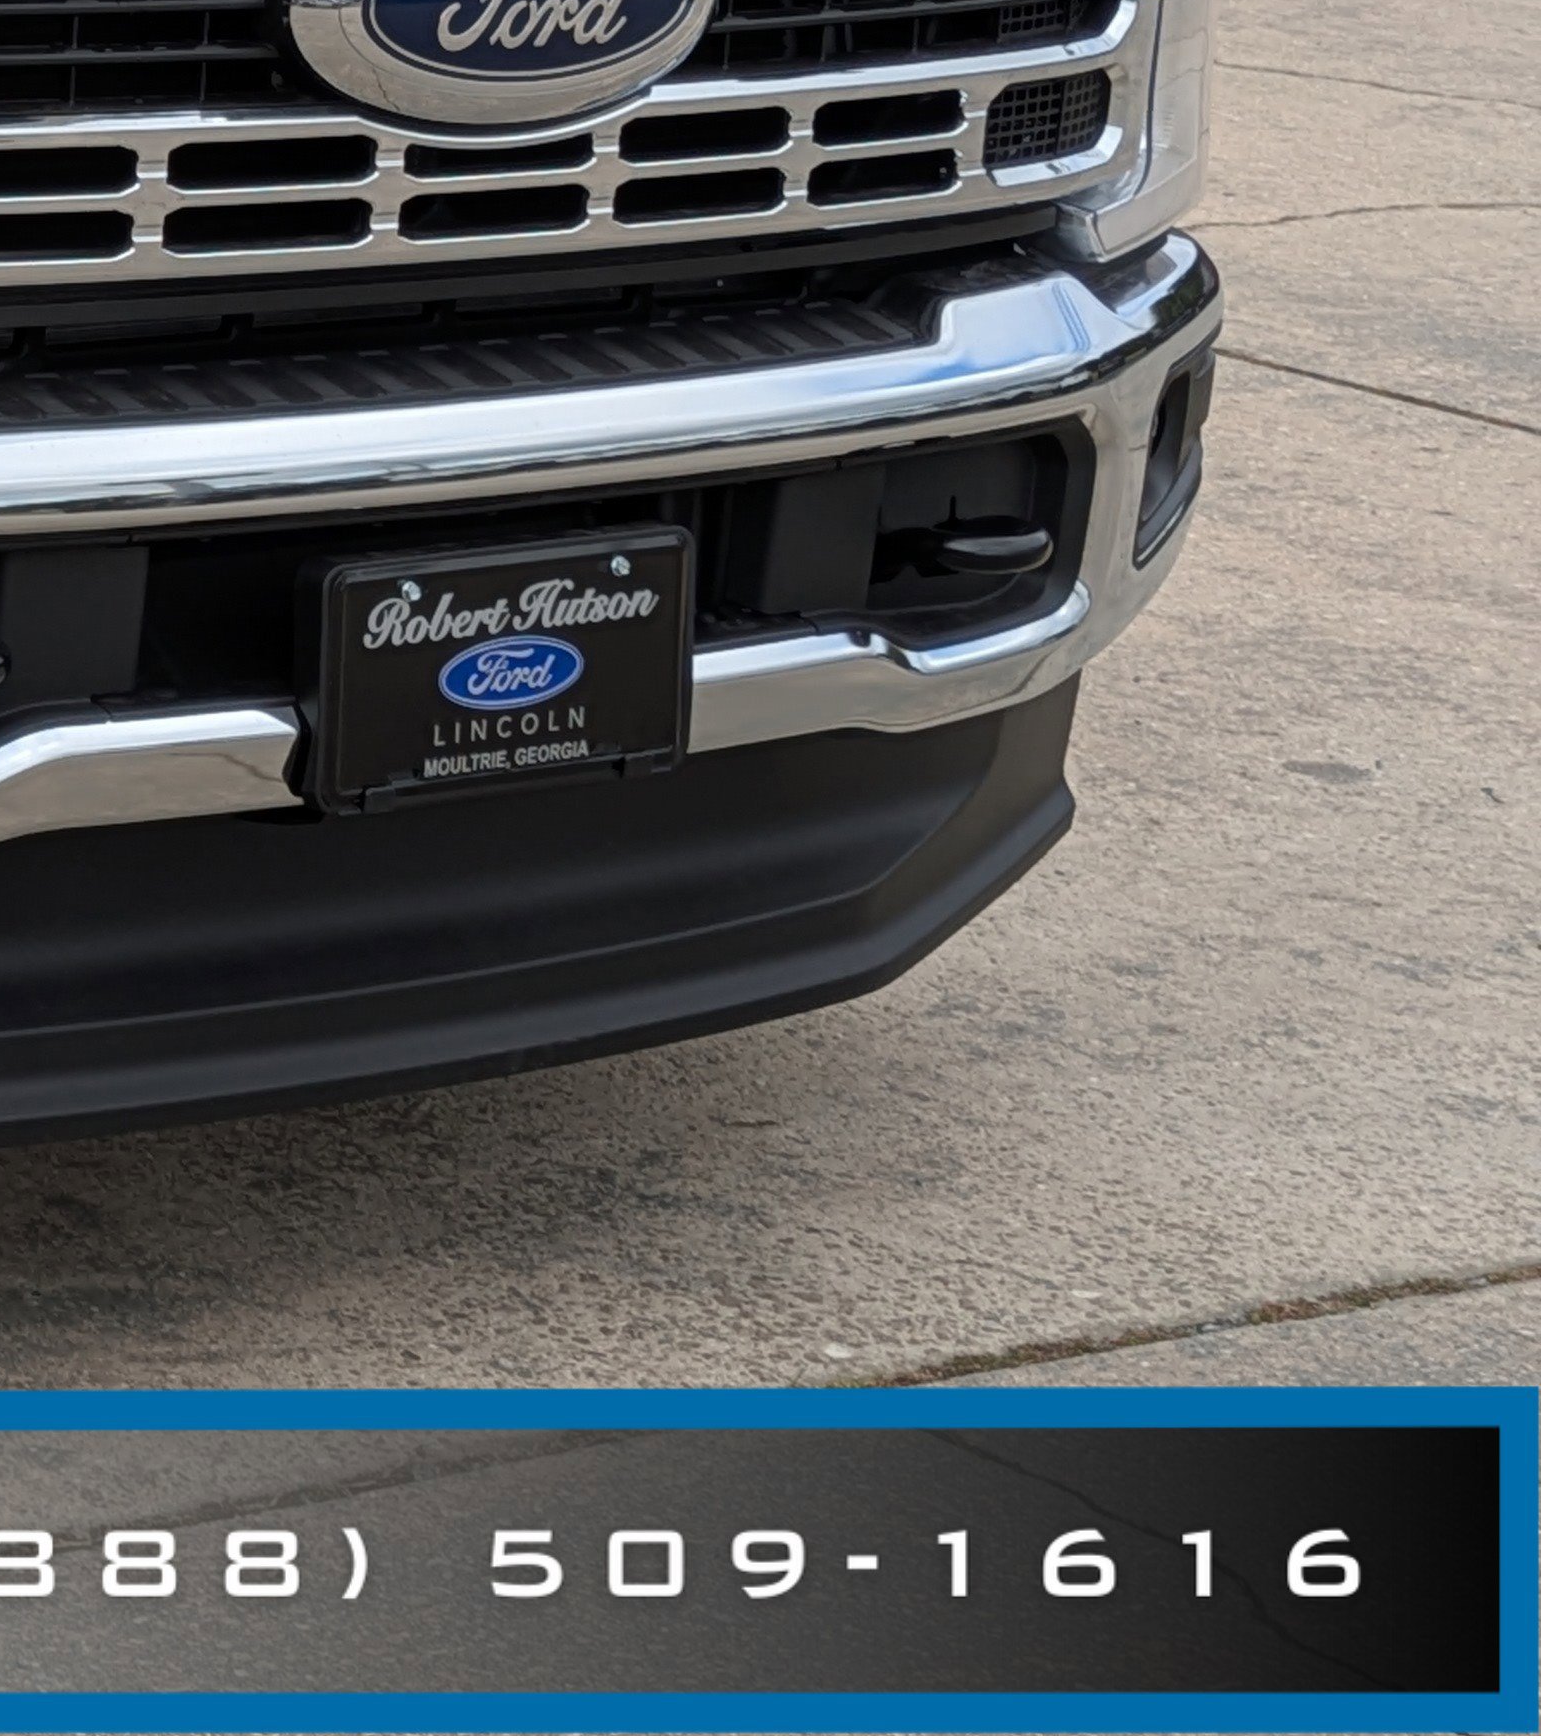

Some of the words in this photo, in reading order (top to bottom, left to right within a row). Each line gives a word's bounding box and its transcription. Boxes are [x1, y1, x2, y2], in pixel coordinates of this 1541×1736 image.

[363, 592, 512, 649] Robert
[512, 578, 659, 632] Hutson
[467, 647, 556, 696] Ford
[433, 706, 586, 748] LINCOLN
[424, 750, 511, 778] MOULTRIE,
[514, 740, 589, 766] GEORGIA
